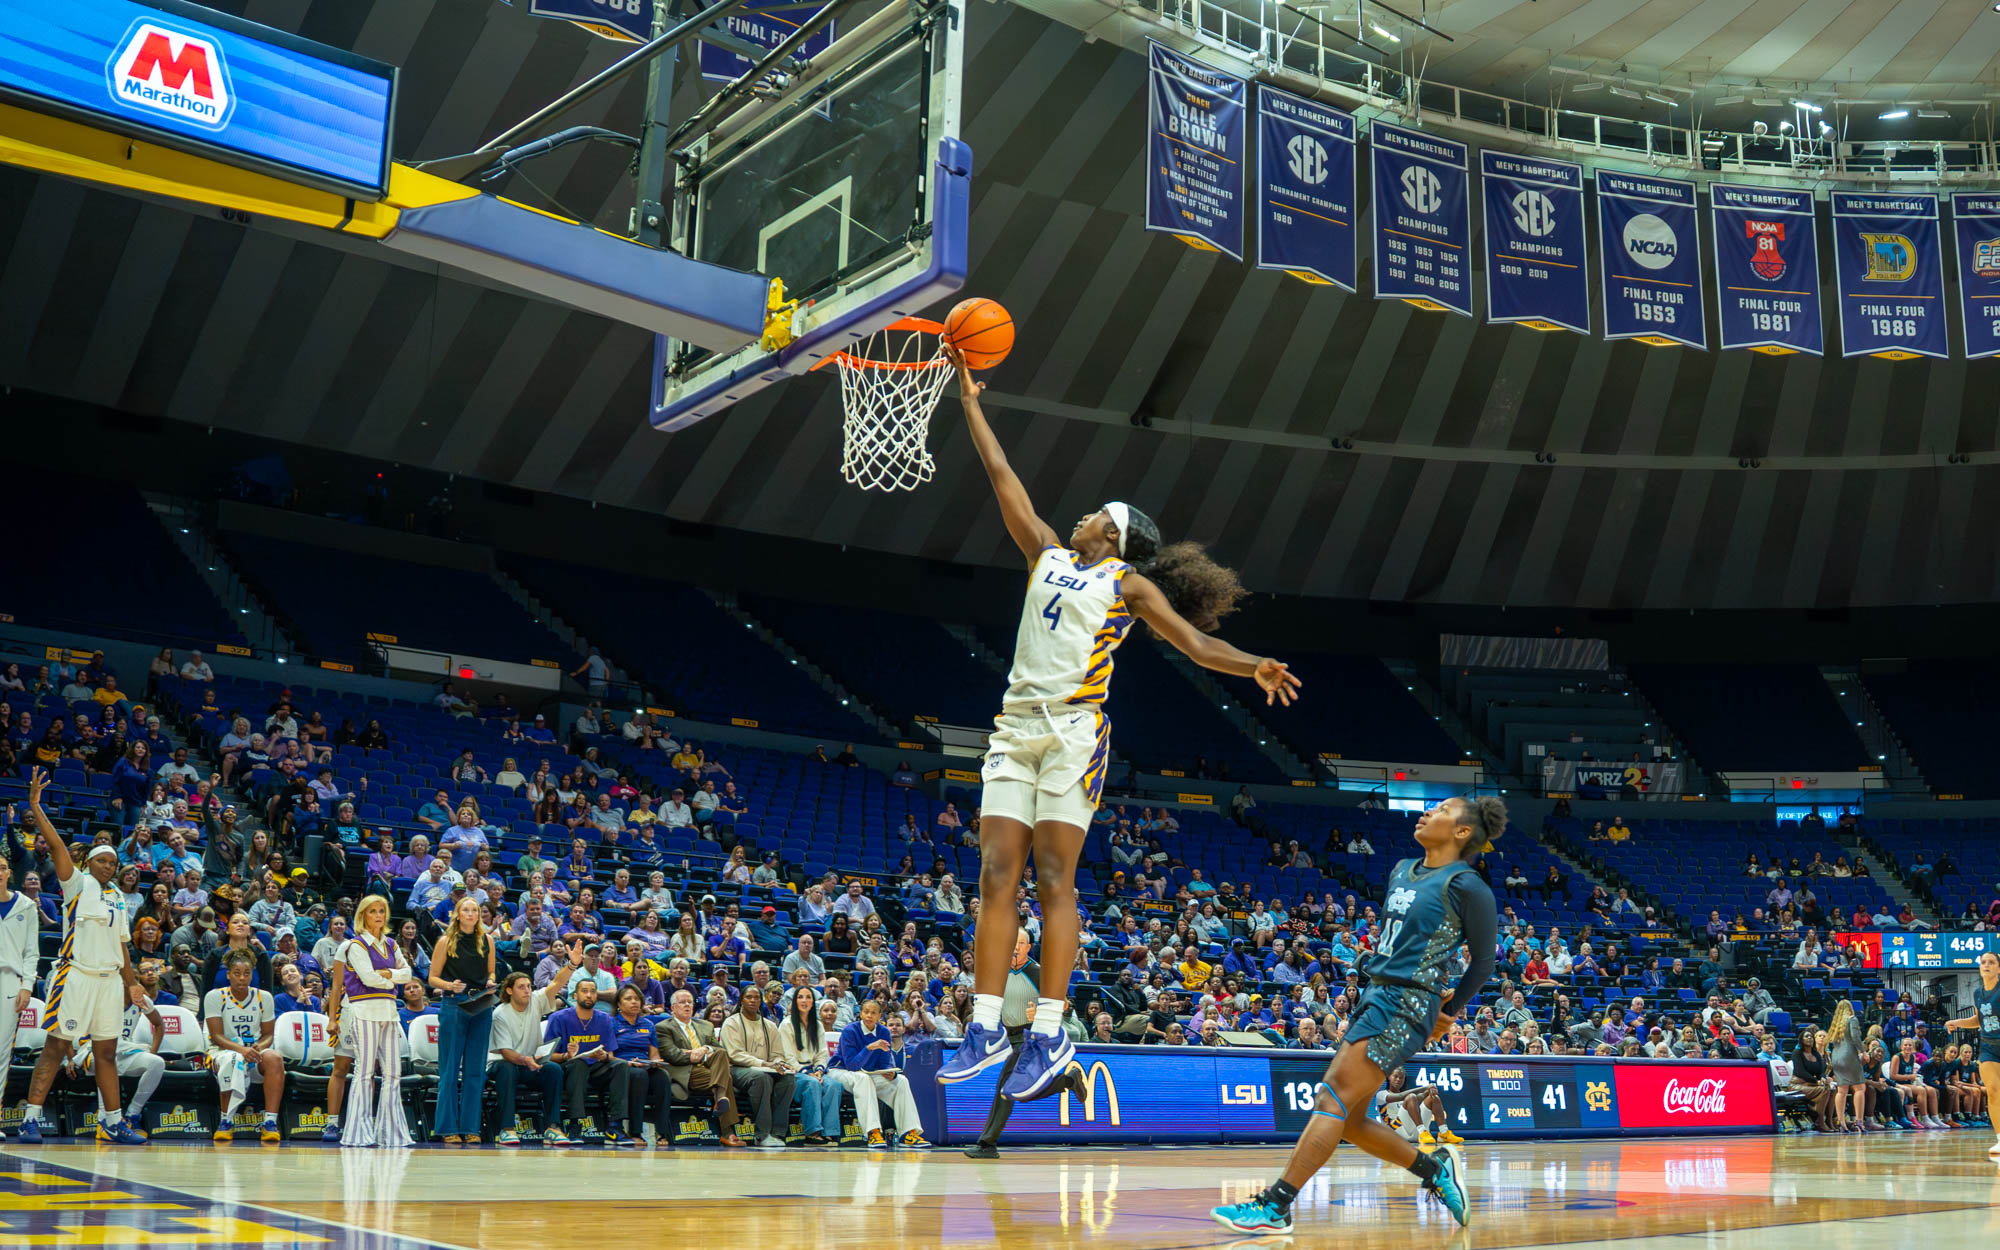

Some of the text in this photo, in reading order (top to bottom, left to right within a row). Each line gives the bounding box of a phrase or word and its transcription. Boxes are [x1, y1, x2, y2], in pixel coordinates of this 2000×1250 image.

[727, 15, 767, 41] FINAL
[1163, 56, 1233, 92] MEN'S BASKETBALL
[123, 79, 216, 117] Marathon
[1186, 92, 1210, 109] COACH
[1179, 101, 1217, 131] DALE
[1272, 99, 1343, 129] MEN'S BASKETBALL
[1168, 114, 1226, 152] BROWN
[1384, 132, 1455, 158] MEN'S BASKETBALL
[1180, 150, 1199, 163] FINAL
[1200, 157, 1220, 171] FOURS
[1287, 134, 1329, 185] SEC
[1183, 163, 1195, 174] SEC
[1197, 168, 1217, 182] TITLES
[1495, 160, 1569, 180] MEN'S BASKETBALL
[1169, 169, 1185, 182] NCAA
[1187, 176, 1233, 200] TOURNAMENTS
[1400, 165, 1442, 214] SEC
[1610, 179, 1683, 197] MEN'S BASKETBALL
[1166, 190, 1228, 219] COACH OF THE YEAR
[1189, 190, 1219, 207] NATIONAL
[1269, 183, 1347, 213] TOURNAMENT CHAMPIONS
[1725, 192, 1800, 206] MEN'S BASKETBALL
[1846, 200, 1924, 210] MEN'S BASKETBALL
[1967, 201, 1994, 210] MEN'S
[1195, 214, 1213, 227] WINS
[1273, 211, 1292, 225] 1980
[1512, 190, 1556, 236] SEC
[1398, 215, 1448, 236] CHAMPIONS
[1751, 222, 1778, 232] NCAA
[1510, 240, 1563, 256] CHAMPIONS
[1630, 239, 1676, 258] NCAA
[1759, 237, 1773, 250] 81
[1440, 251, 1458, 263] 1954
[1414, 273, 1434, 286] 2000
[1528, 268, 1548, 279] 2019
[1623, 286, 1684, 305] FINAL FOUR
[1633, 302, 1676, 324] 1953
[1739, 298, 1801, 313] FINAL FOUR
[1861, 305, 1925, 317] FINAL FOUR
[1752, 313, 1791, 332] 1981
[1871, 319, 1916, 337] 1986
[1043, 571, 1088, 591] LSU
[1043, 592, 1062, 630] 4
[1788, 811, 1796, 819] OF
[1925, 941, 1933, 952] 2
[1950, 937, 1985, 951] 4:45
[1891, 950, 1909, 965] 41
[231, 1015, 253, 1023] LSU
[234, 1025, 250, 1037] 12
[1415, 1067, 1464, 1091] 4:45
[1486, 1069, 1524, 1079] TIMEOUTS
[1221, 1084, 1267, 1105] LSU
[1543, 1084, 1567, 1110] 41
[161, 1110, 197, 1126] Bengal
[1457, 1107, 1468, 1124] 4
[1488, 1103, 1531, 1123] 2 FOULS
[679, 1121, 709, 1133] Bengal
